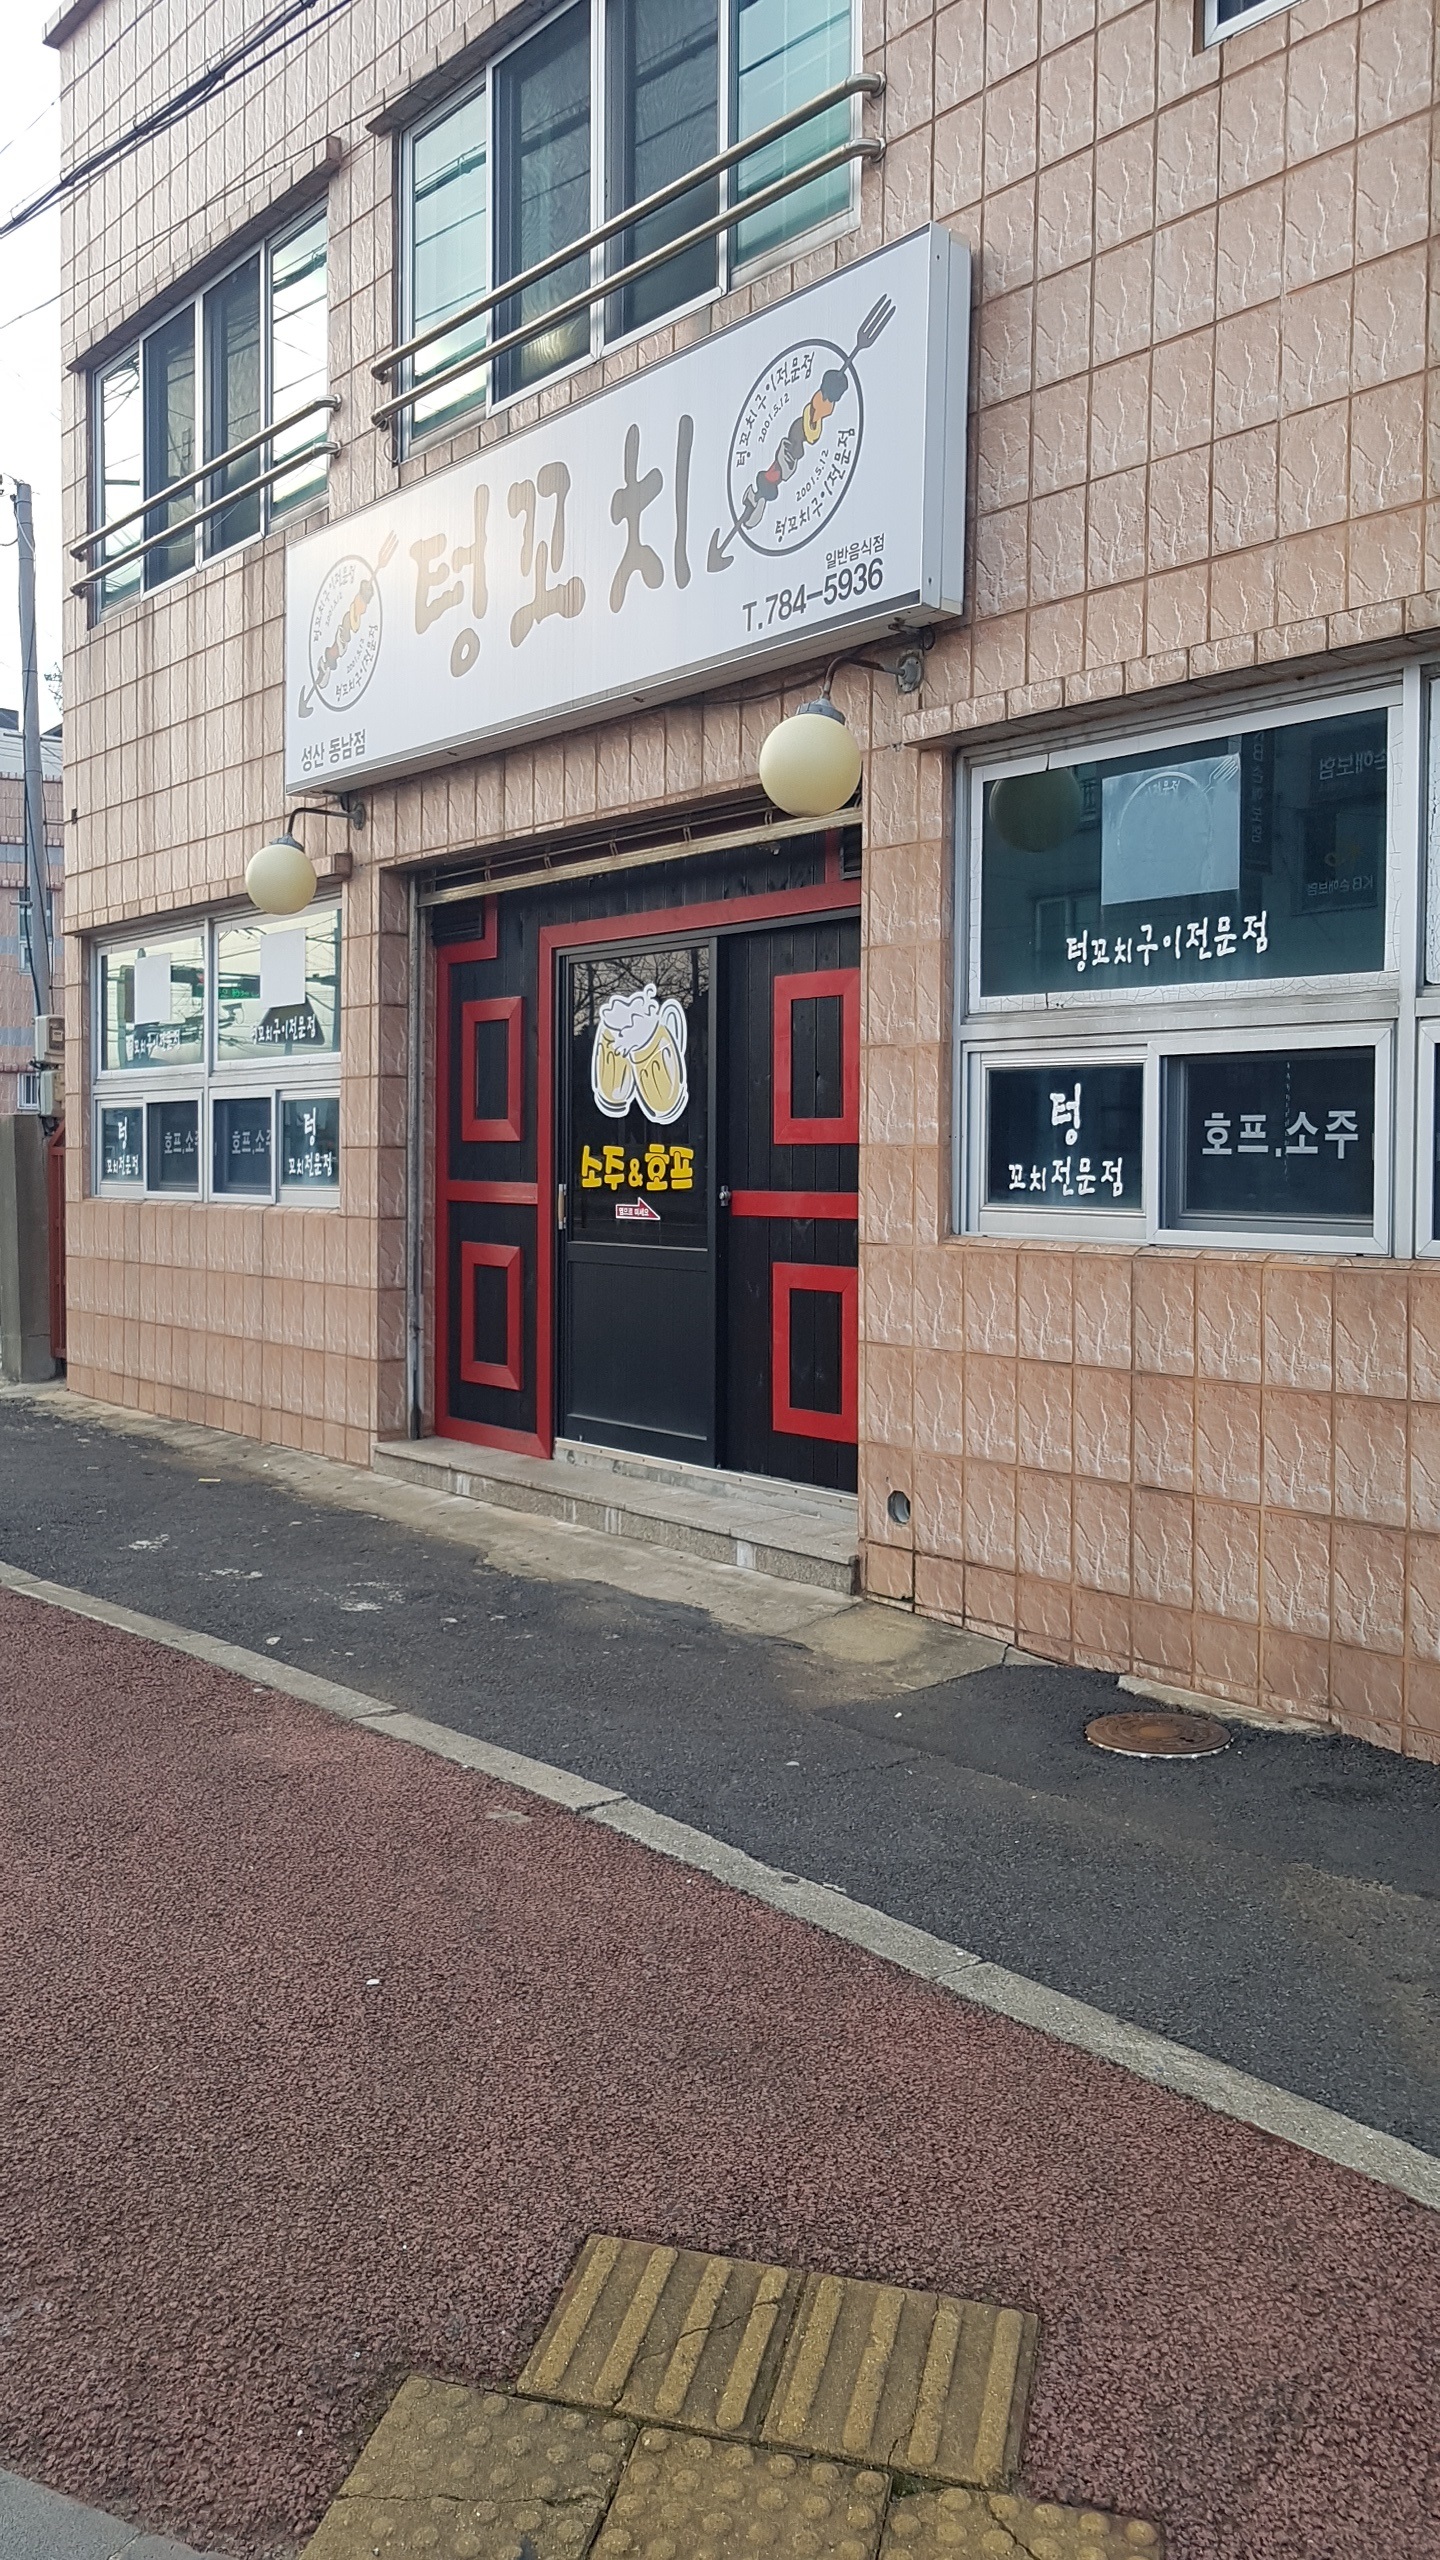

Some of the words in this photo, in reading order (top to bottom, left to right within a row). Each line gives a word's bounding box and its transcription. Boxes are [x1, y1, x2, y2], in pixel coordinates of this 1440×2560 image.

[735, 351, 816, 468] 텅꼬치구이전문점
[758, 392, 790, 443] 2001.5.12
[774, 428, 856, 543] 텅꼬치구이전문점
[795, 449, 829, 502] 2001.5.12
[409, 414, 694, 678] 텅꼬치
[825, 533, 885, 570] 일반음식점
[742, 558, 884, 632] T.784-5936
[301, 742, 325, 772] 성산
[328, 728, 367, 765] 동남점
[1065, 910, 1270, 972] 텅꼬치구이전문점
[303, 1106, 317, 1147] 텅
[1050, 1083, 1082, 1146] 텅
[288, 1151, 333, 1178] 꼬치전문점
[580, 1144, 695, 1192] 소주&호프
[1007, 1155, 1125, 1198] 꼬치전문점
